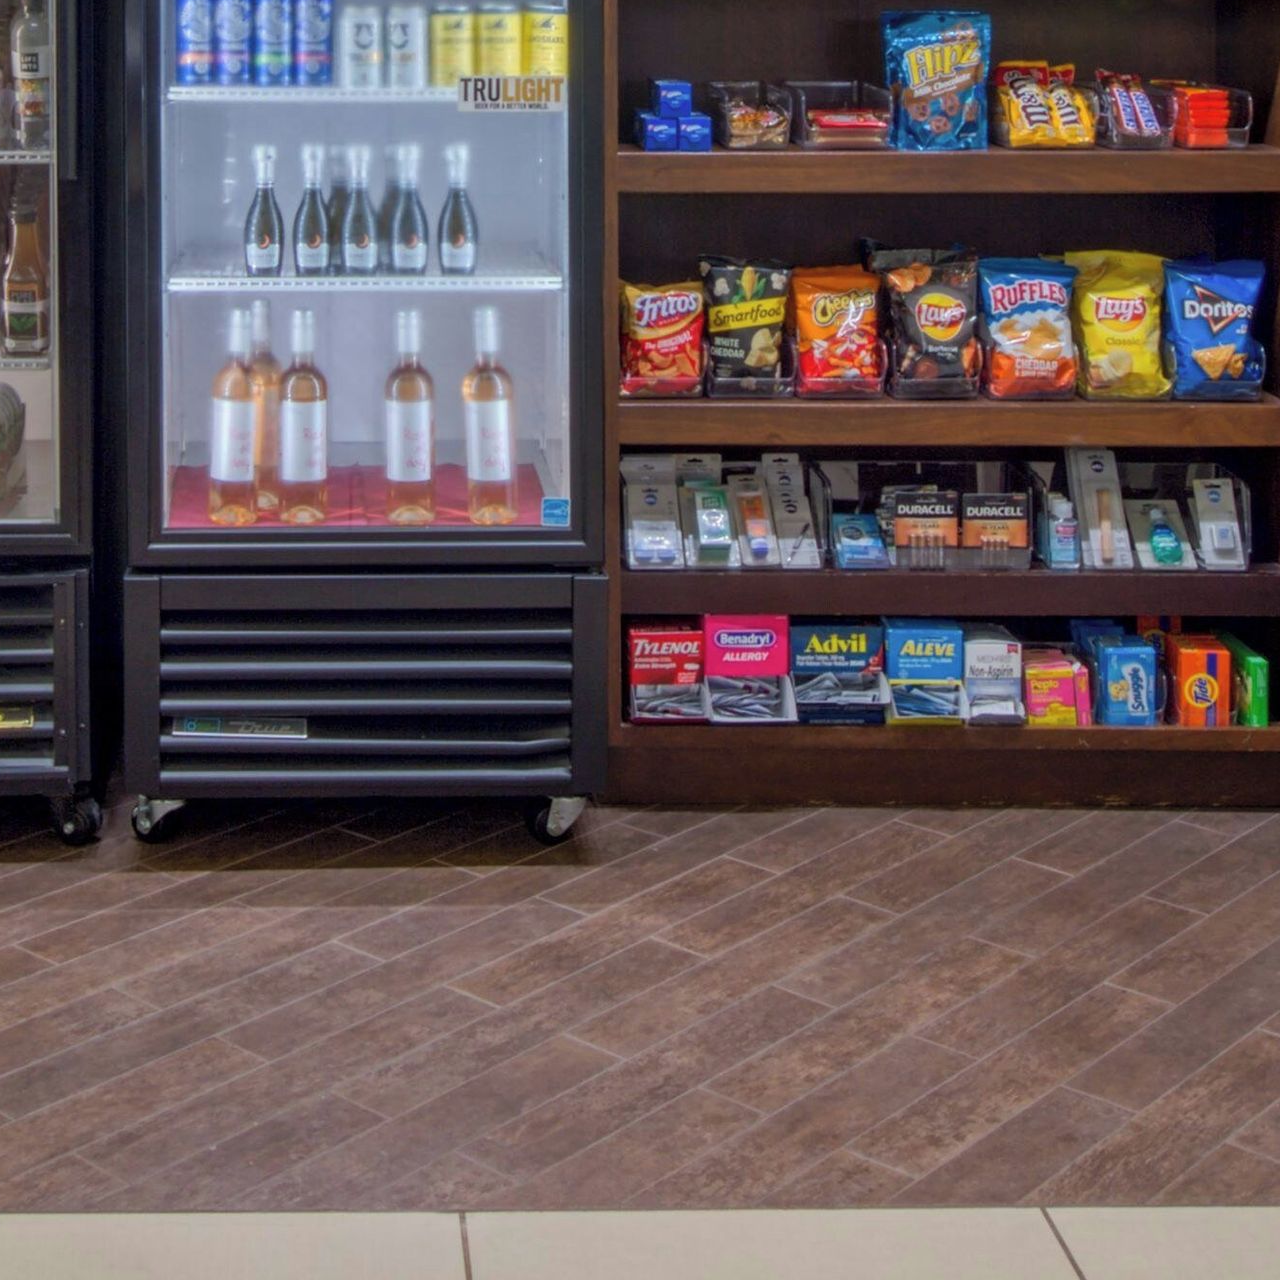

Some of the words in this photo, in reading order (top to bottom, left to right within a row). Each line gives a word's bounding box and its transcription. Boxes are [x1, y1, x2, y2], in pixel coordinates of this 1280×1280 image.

[906, 41, 979, 87] Flipz
[990, 280, 1067, 314] RUFFLES
[635, 292, 699, 327] Fritos
[713, 303, 783, 327] Smartfood
[1184, 299, 1254, 319] Doritos
[714, 336, 740, 347] WHITE
[710, 347, 745, 359] CHEDDAR
[897, 504, 954, 515] DURACELL
[966, 506, 1023, 517] DURACELL
[633, 639, 701, 656] TYLENOL
[719, 633, 770, 648] Benadryl
[804, 633, 867, 654] Advil
[900, 639, 956, 657] ALEVE
[722, 652, 769, 662] ALLERGY
[1129, 666, 1145, 713] Snuggle
[1194, 677, 1211, 705] Tide
